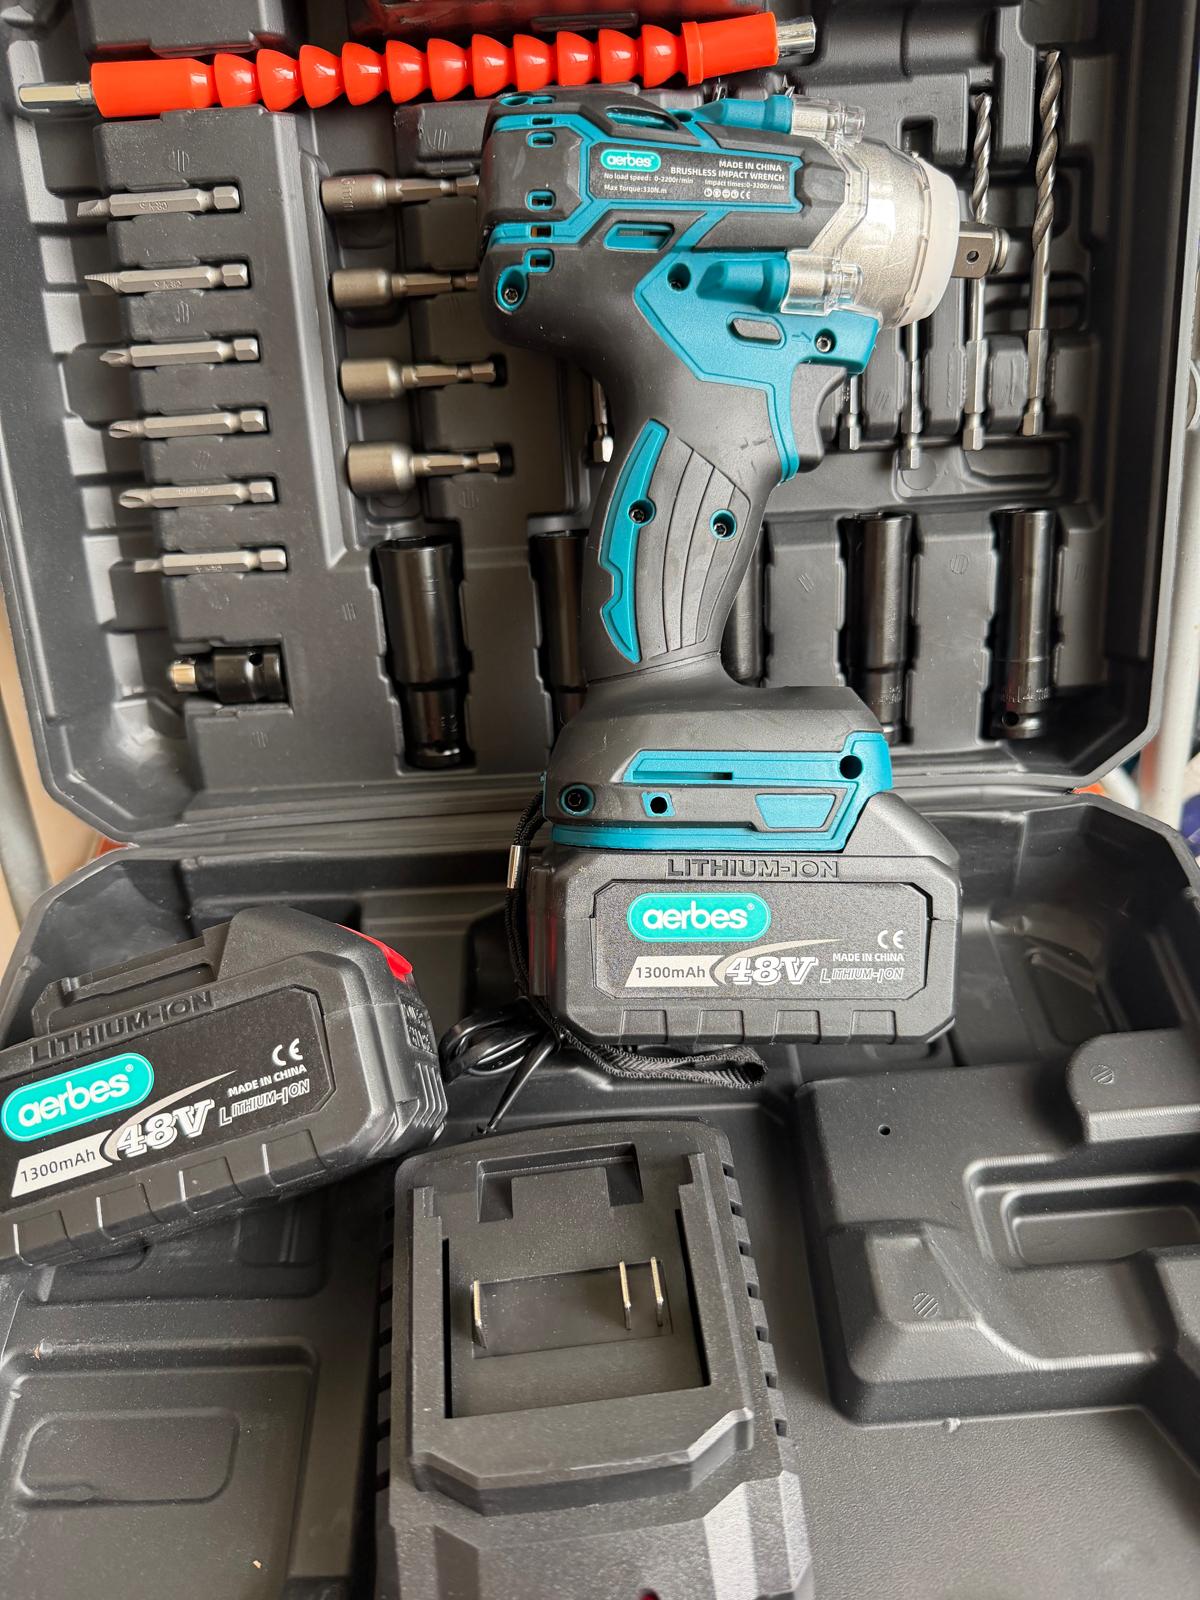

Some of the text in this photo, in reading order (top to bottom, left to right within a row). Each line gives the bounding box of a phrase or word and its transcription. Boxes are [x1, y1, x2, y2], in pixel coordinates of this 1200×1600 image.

[670, 167, 785, 182] BRUSHLESS IMPACT WRENCH
[719, 160, 782, 172] MADE IN CHINA
[705, 179, 726, 187] Impact
[668, 858, 840, 878] LITHIUM-ION
[877, 930, 904, 950] CE
[832, 953, 905, 962] MADE IN CHINA
[636, 956, 904, 986] 1300mAh 48V LITHIUM-ION
[31, 991, 214, 1062] LITHIUM-ION
[272, 1038, 304, 1066] CE
[228, 1065, 307, 1097] MADE IN CHINA
[116, 1080, 310, 1158] 48V LITHIUM-ION
[20, 1150, 96, 1183] 1300mAh
